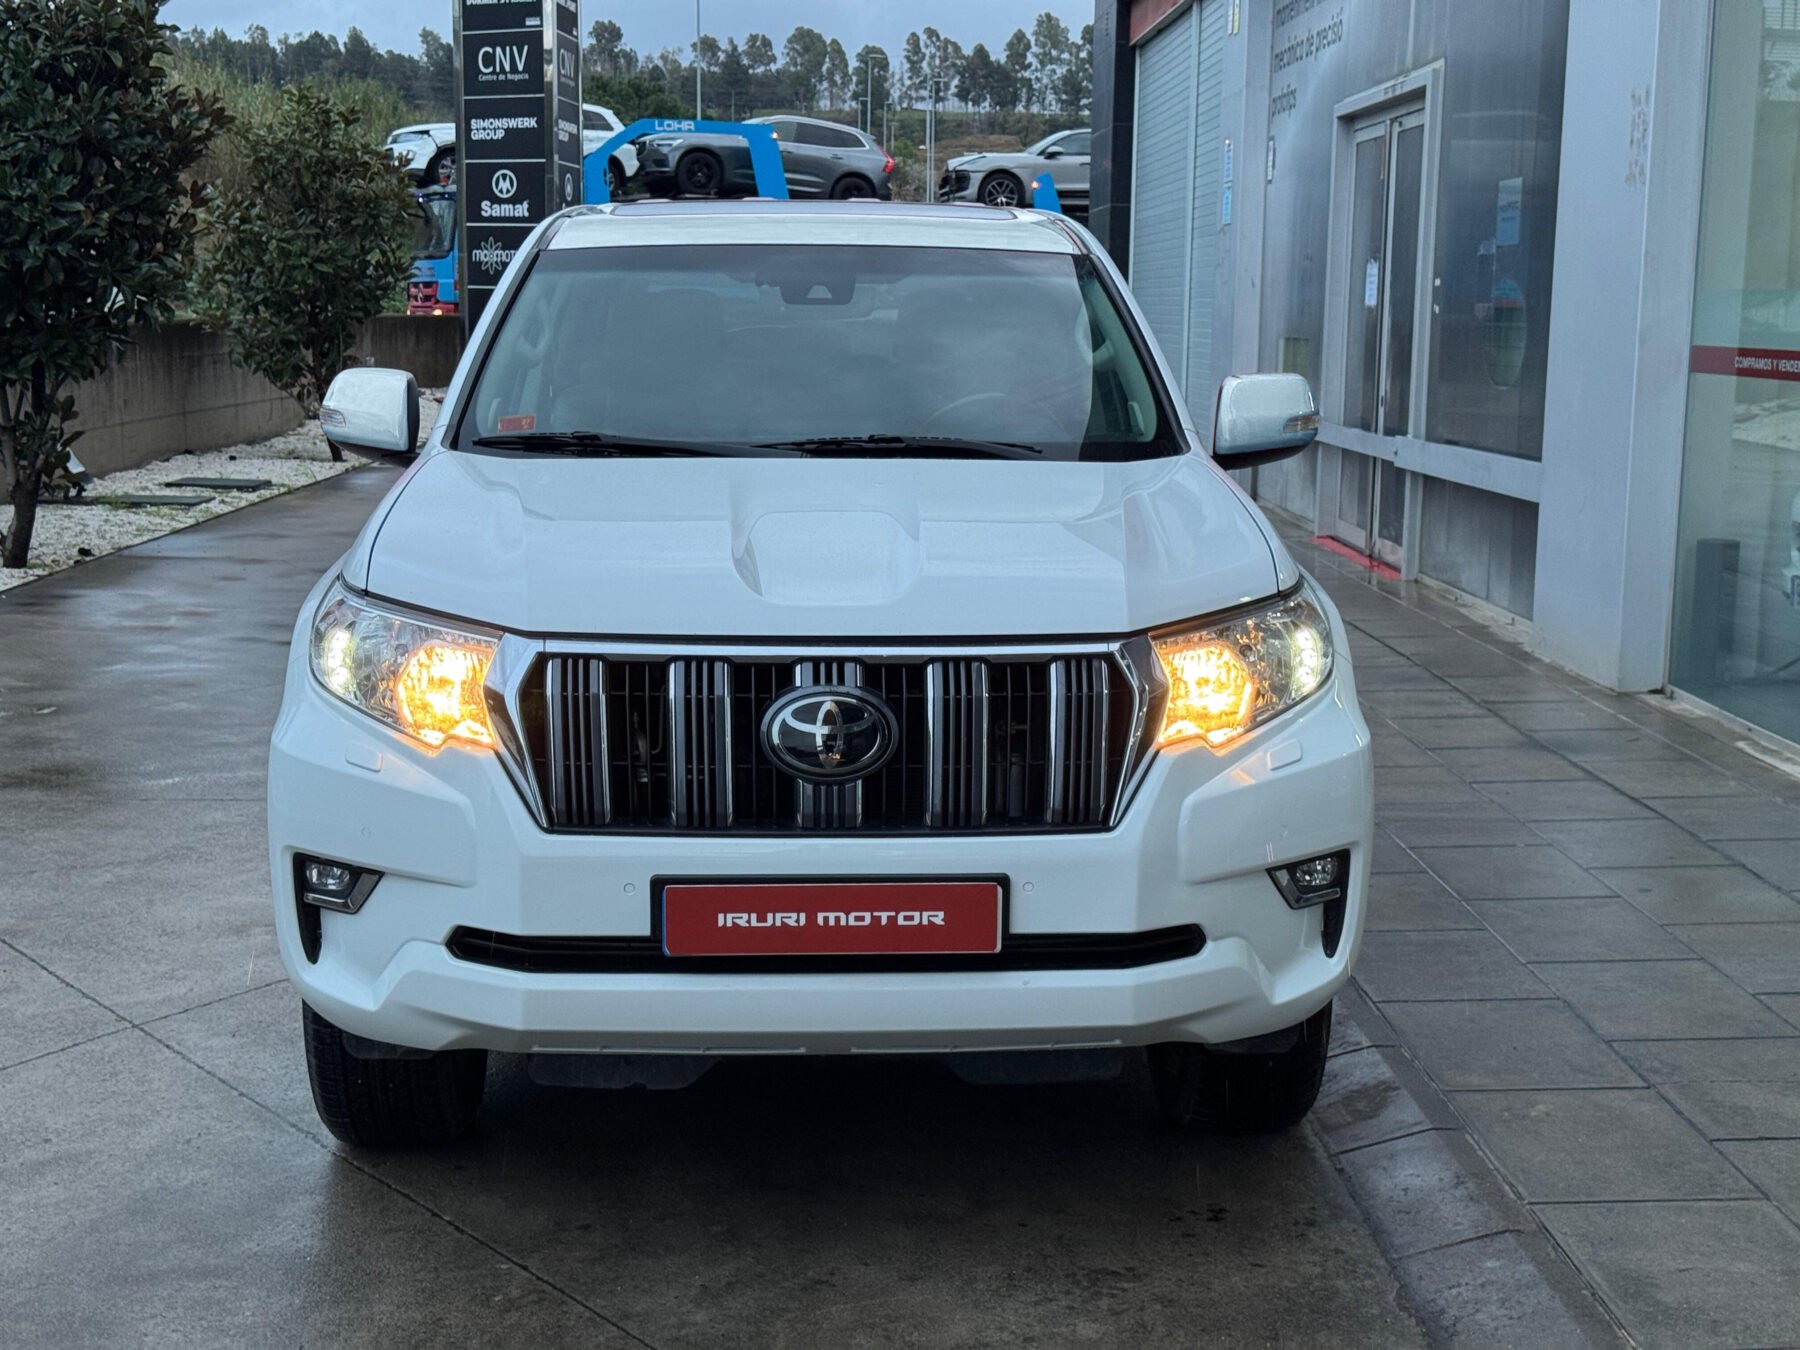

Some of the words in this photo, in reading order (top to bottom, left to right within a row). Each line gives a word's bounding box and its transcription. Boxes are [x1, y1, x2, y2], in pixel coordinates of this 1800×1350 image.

[478, 45, 528, 73] CNV
[471, 117, 538, 129] SIMONSWERK
[655, 120, 695, 131] LOHR
[471, 130, 505, 140] GROUP
[481, 200, 529, 217] Samat
[1772, 359, 1778, 371] Y
[1778, 359, 1800, 373] VENDE
[718, 912, 806, 928] IRURI
[817, 911, 945, 926] MOTOR
